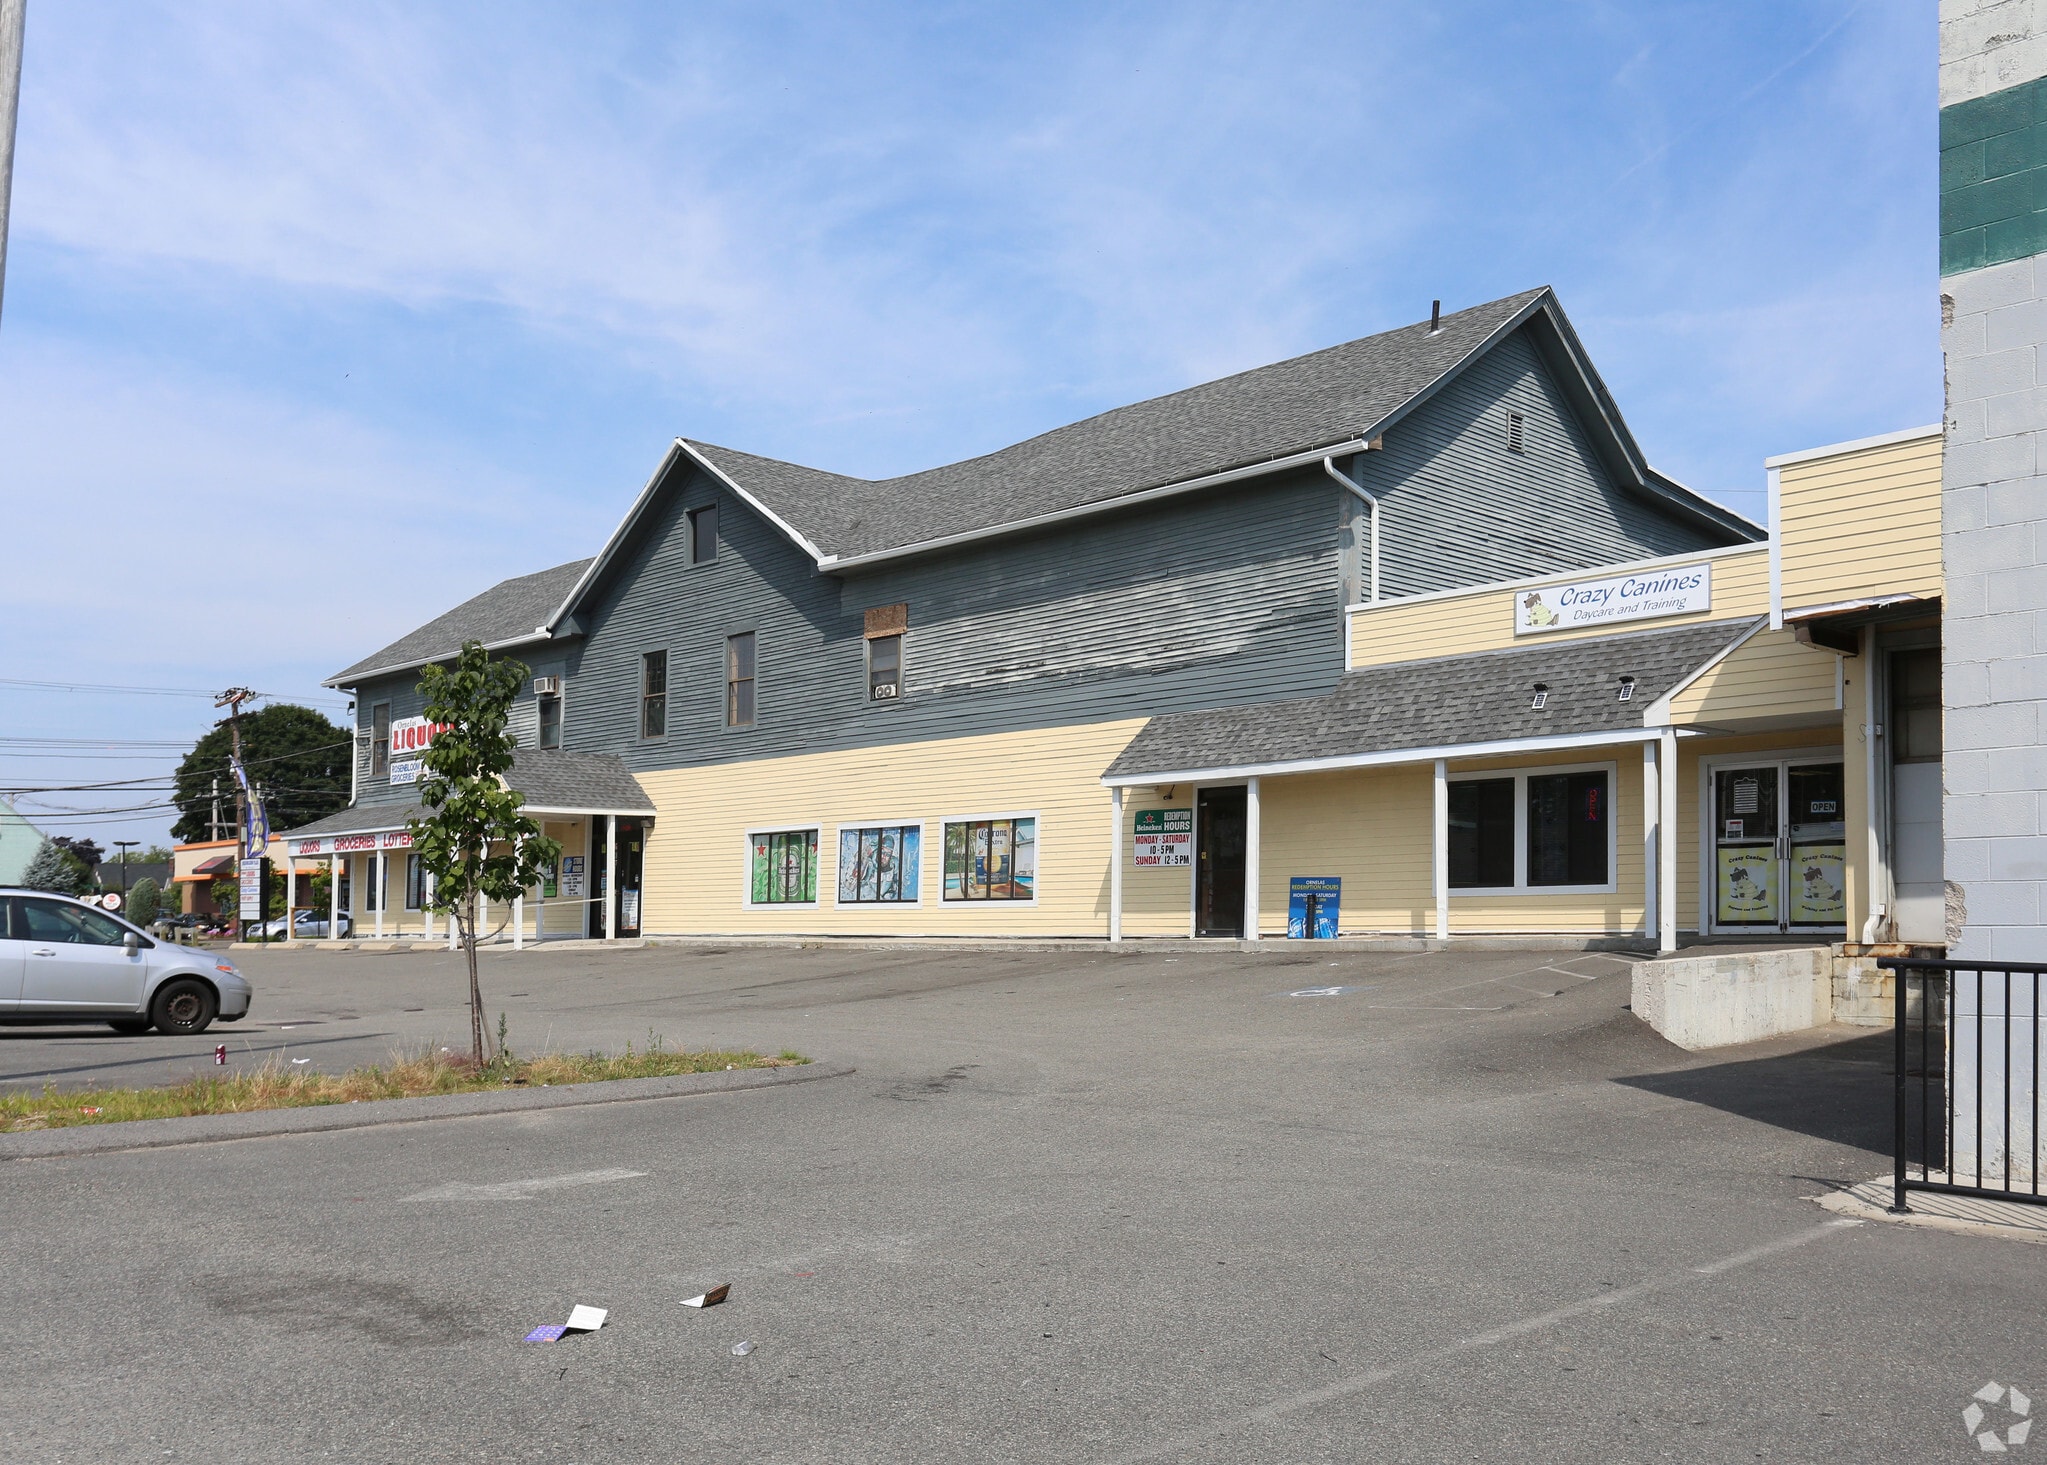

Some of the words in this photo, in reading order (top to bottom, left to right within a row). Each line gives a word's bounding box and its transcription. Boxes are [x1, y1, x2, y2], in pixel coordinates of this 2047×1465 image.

[1560, 586, 1615, 607] Crazy
[1620, 573, 1702, 598] Canines
[1573, 607, 1615, 621] Daycare
[1617, 604, 1639, 615] and
[1643, 597, 1688, 610] Training
[1812, 802, 1835, 811] OPEN
[1164, 811, 1190, 821] REDEMPTION
[1136, 824, 1163, 832] Heineken
[1164, 821, 1191, 831] HOURS
[299, 840, 320, 854] LIQUORS
[334, 835, 376, 851] GROCERIES
[383, 832, 413, 847] LOTTER
[1135, 835, 1159, 844] MONDAY
[1162, 834, 1190, 844] SATURDAY
[1165, 845, 1175, 854] PM
[1135, 856, 1161, 865] SUNDAY
[1179, 855, 1190, 864] PM
